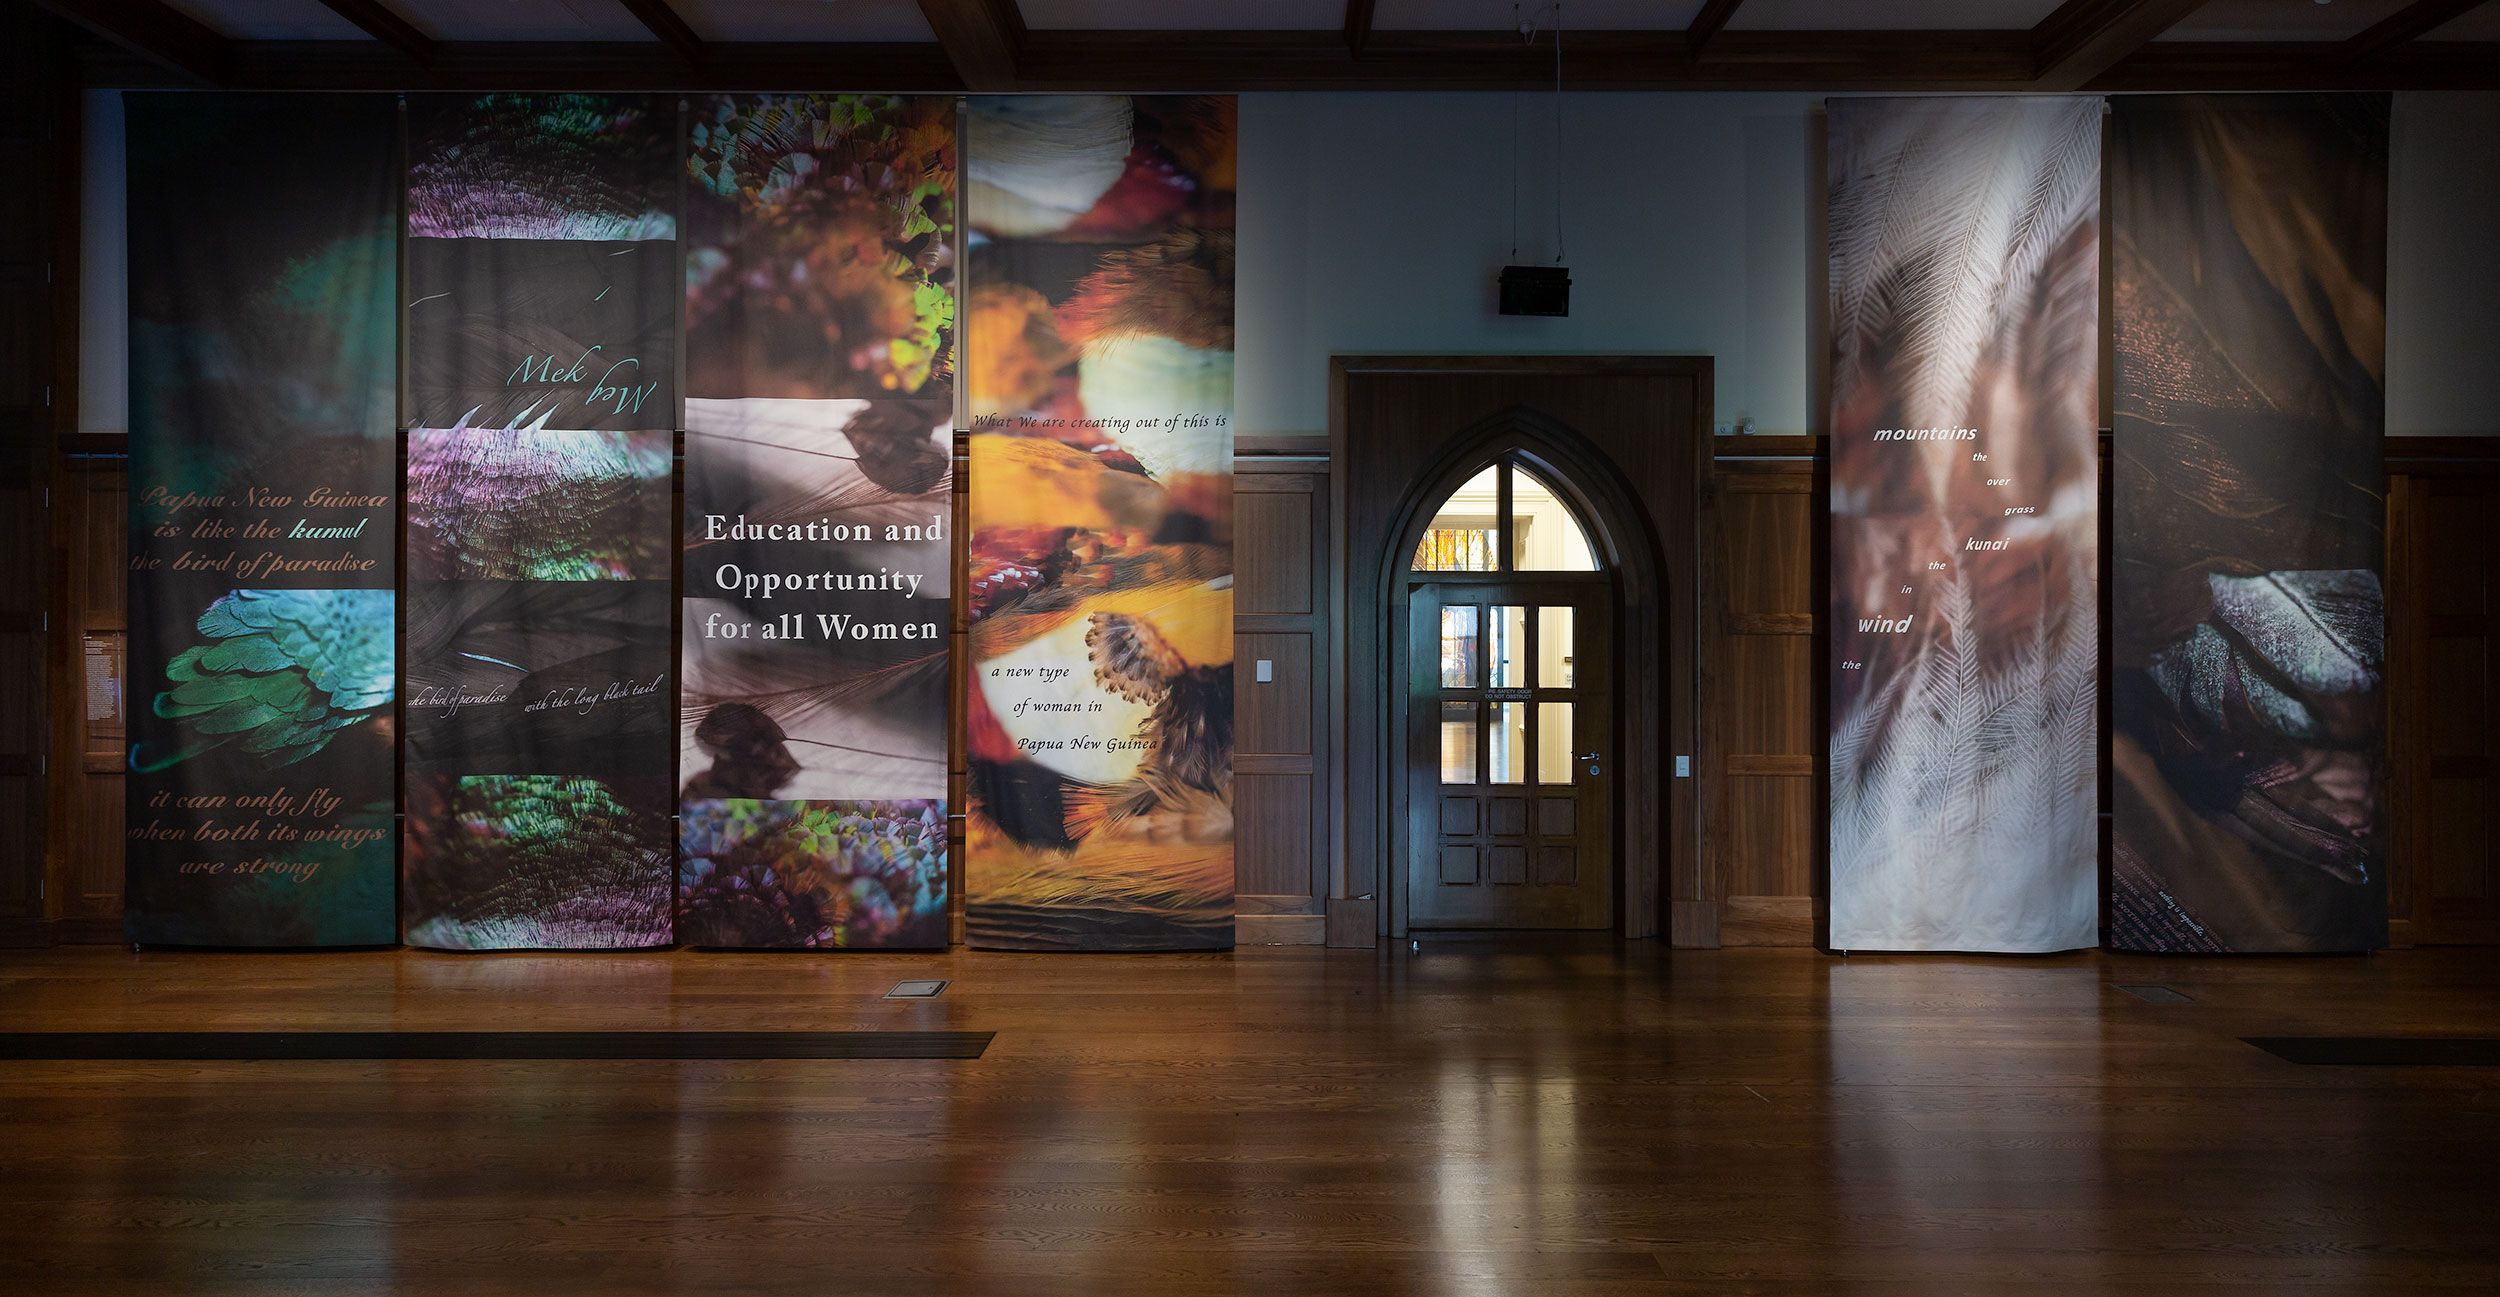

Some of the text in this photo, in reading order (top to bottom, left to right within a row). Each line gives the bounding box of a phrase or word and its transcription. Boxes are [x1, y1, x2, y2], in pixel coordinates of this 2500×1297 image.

[506, 344, 602, 387] Mek
[974, 412, 1228, 433] What We are creating out of this is
[1873, 425, 1978, 442] mountains
[1972, 452, 1988, 462] the
[1986, 476, 2011, 487] over
[138, 484, 390, 514] Papua New Guinea
[2004, 504, 2035, 516] grass
[153, 517, 369, 539] is like the kumul
[704, 513, 944, 542] Education and
[1965, 537, 2011, 551] kunai
[129, 550, 380, 580] the bird of paradise
[1928, 561, 1947, 570] the
[715, 563, 924, 600] Opportunity
[1901, 584, 1913, 594] in
[704, 611, 939, 641] for all Women
[1857, 614, 1914, 634] wind
[991, 665, 1070, 683] a new type
[1841, 660, 1861, 670] the
[429, 686, 454, 706] bird
[440, 684, 466, 719] of
[452, 684, 508, 716] paradise
[524, 673, 664, 716] with the long black tail
[1012, 697, 1103, 718] of woman in
[1017, 734, 1158, 755] Papua New Guinea
[148, 786, 344, 817] it can only fly
[127, 819, 387, 850] when both its wings
[179, 857, 322, 883] are strong
